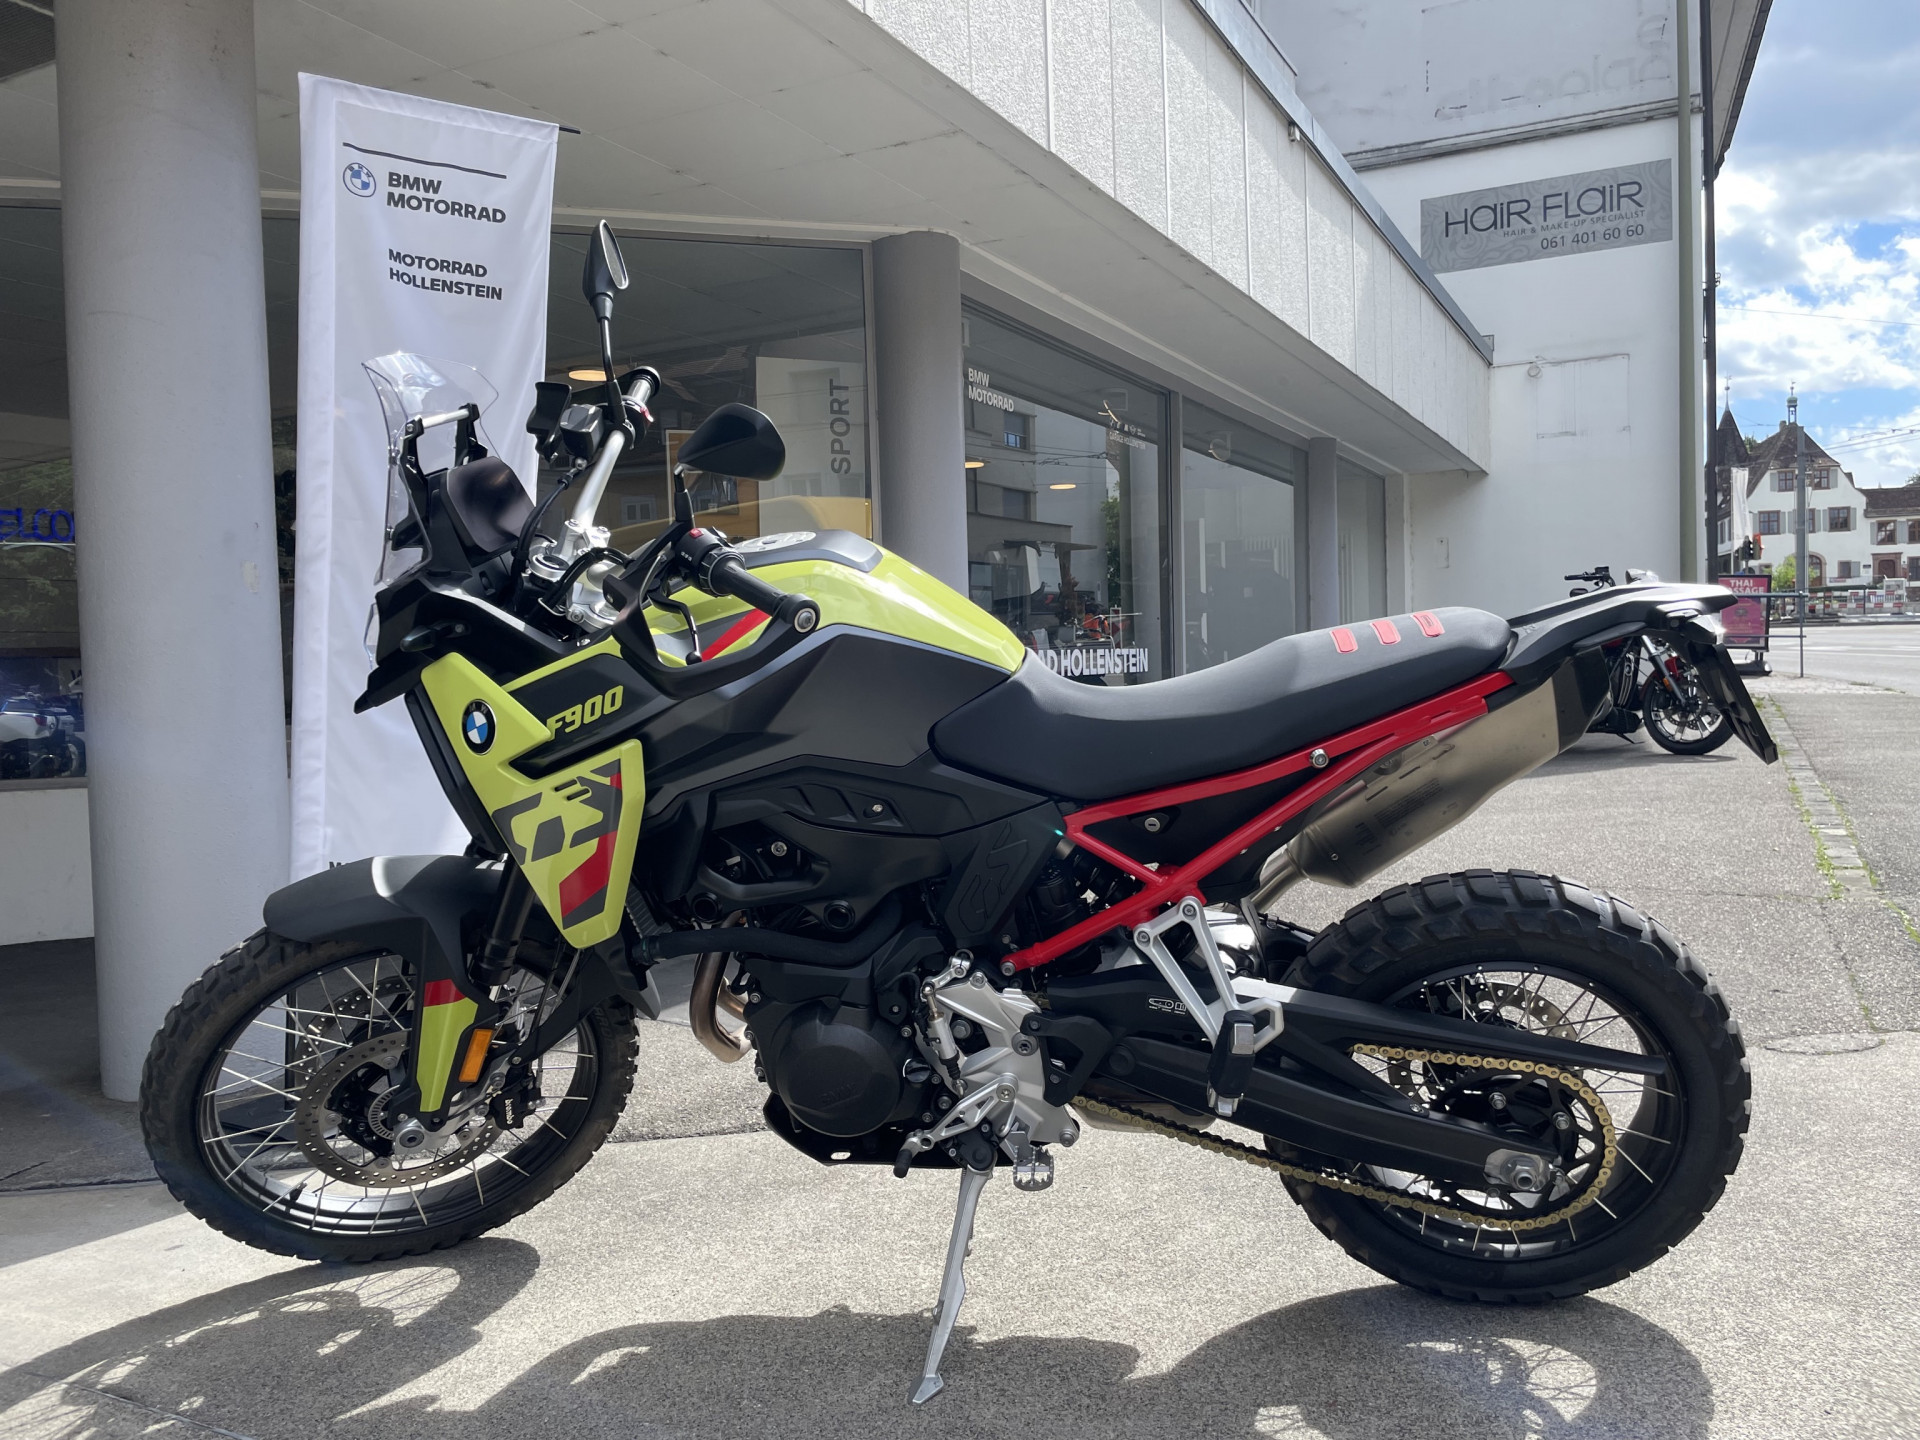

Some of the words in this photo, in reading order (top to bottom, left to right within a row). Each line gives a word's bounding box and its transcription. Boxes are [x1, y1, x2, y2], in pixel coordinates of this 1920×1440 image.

[387, 171, 442, 195] BMW
[386, 191, 507, 224] MOTORRAD
[1503, 228, 1526, 238] HAIR
[1540, 218, 1587, 233] MAKE-UP
[1590, 210, 1646, 225] SPECIALIST
[1540, 236, 1566, 250] 061
[1571, 231, 1597, 245] 401
[1603, 227, 1621, 241] 60
[1626, 223, 1645, 238] 60
[388, 248, 488, 278] MOTORRAD
[389, 267, 503, 301] HOLLENSTEIN
[968, 367, 990, 388] BMW
[968, 384, 1014, 412] MOTORRAD
[829, 378, 851, 475] SPORT
[0, 508, 75, 542] ELCO
[1728, 586, 1765, 594] ASSAGE
[1729, 579, 1754, 587] THAI
[1060, 648, 1149, 677] HOLLENSTEIN
[546, 685, 624, 741] F900
[505, 1098, 514, 1125] brembo
